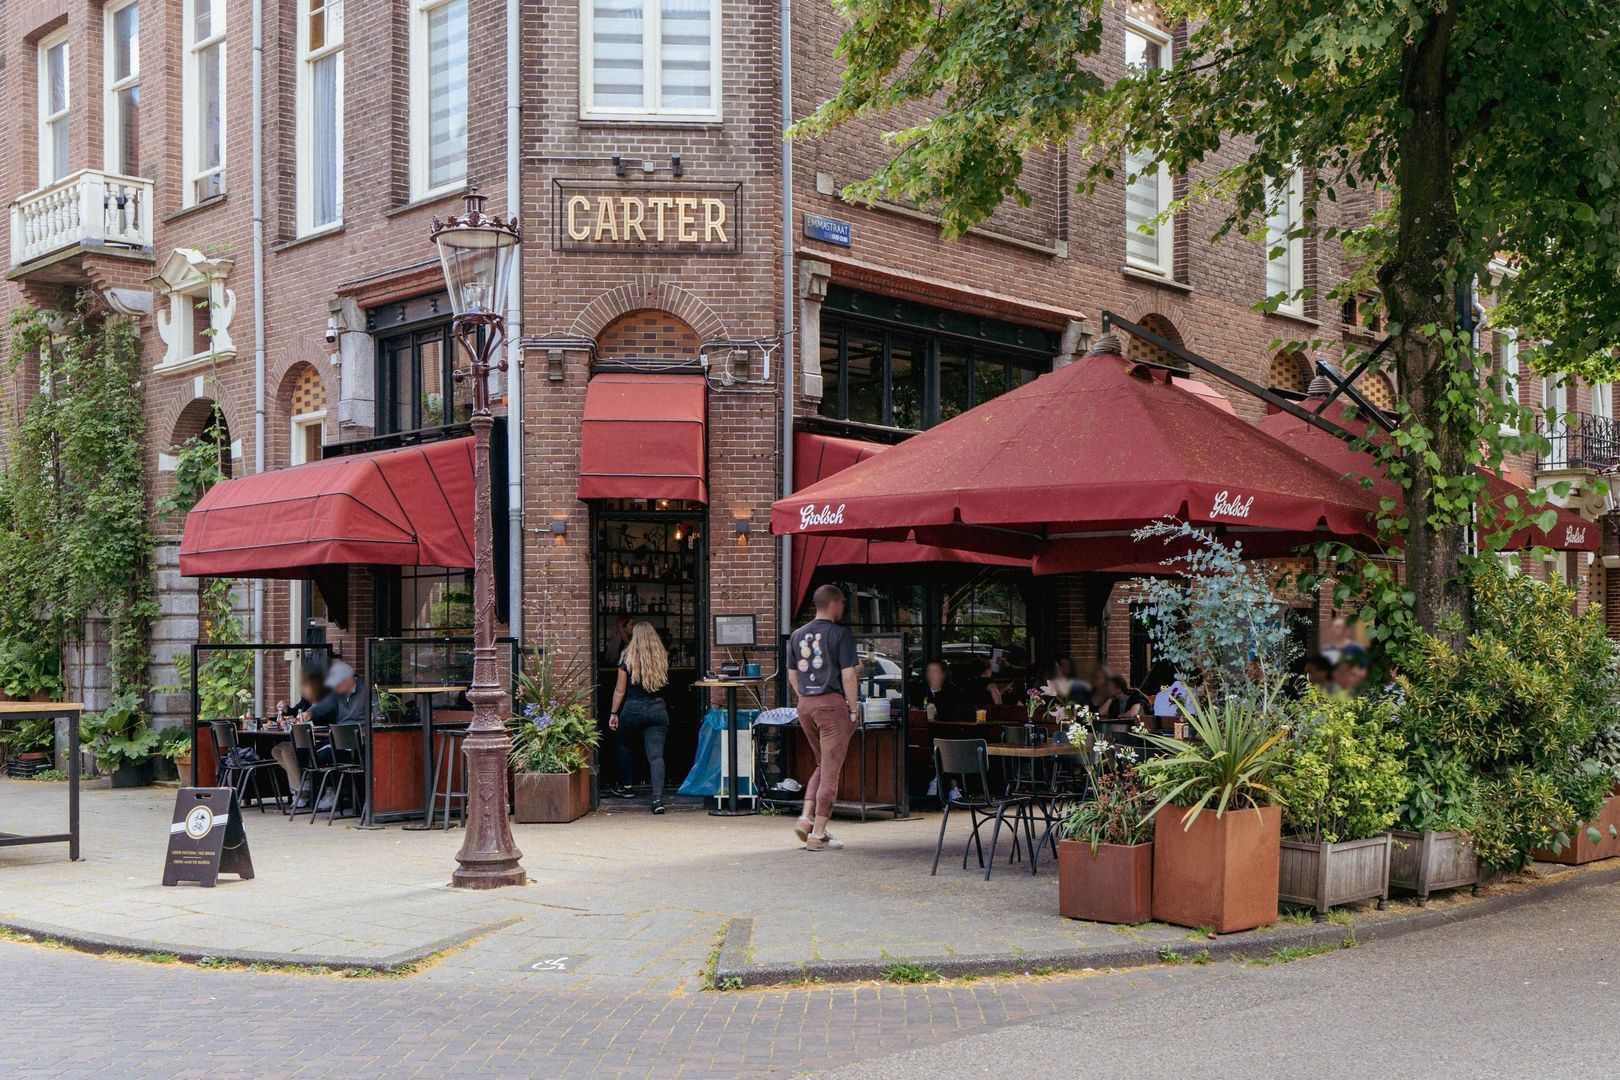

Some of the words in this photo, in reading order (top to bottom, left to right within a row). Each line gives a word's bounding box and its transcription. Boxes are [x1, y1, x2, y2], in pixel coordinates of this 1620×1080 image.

[568, 195, 729, 243] CARTER
[807, 217, 849, 235] EMMASTRAAT
[800, 503, 846, 530] Grolsch
[1210, 490, 1254, 518] Grolsch
